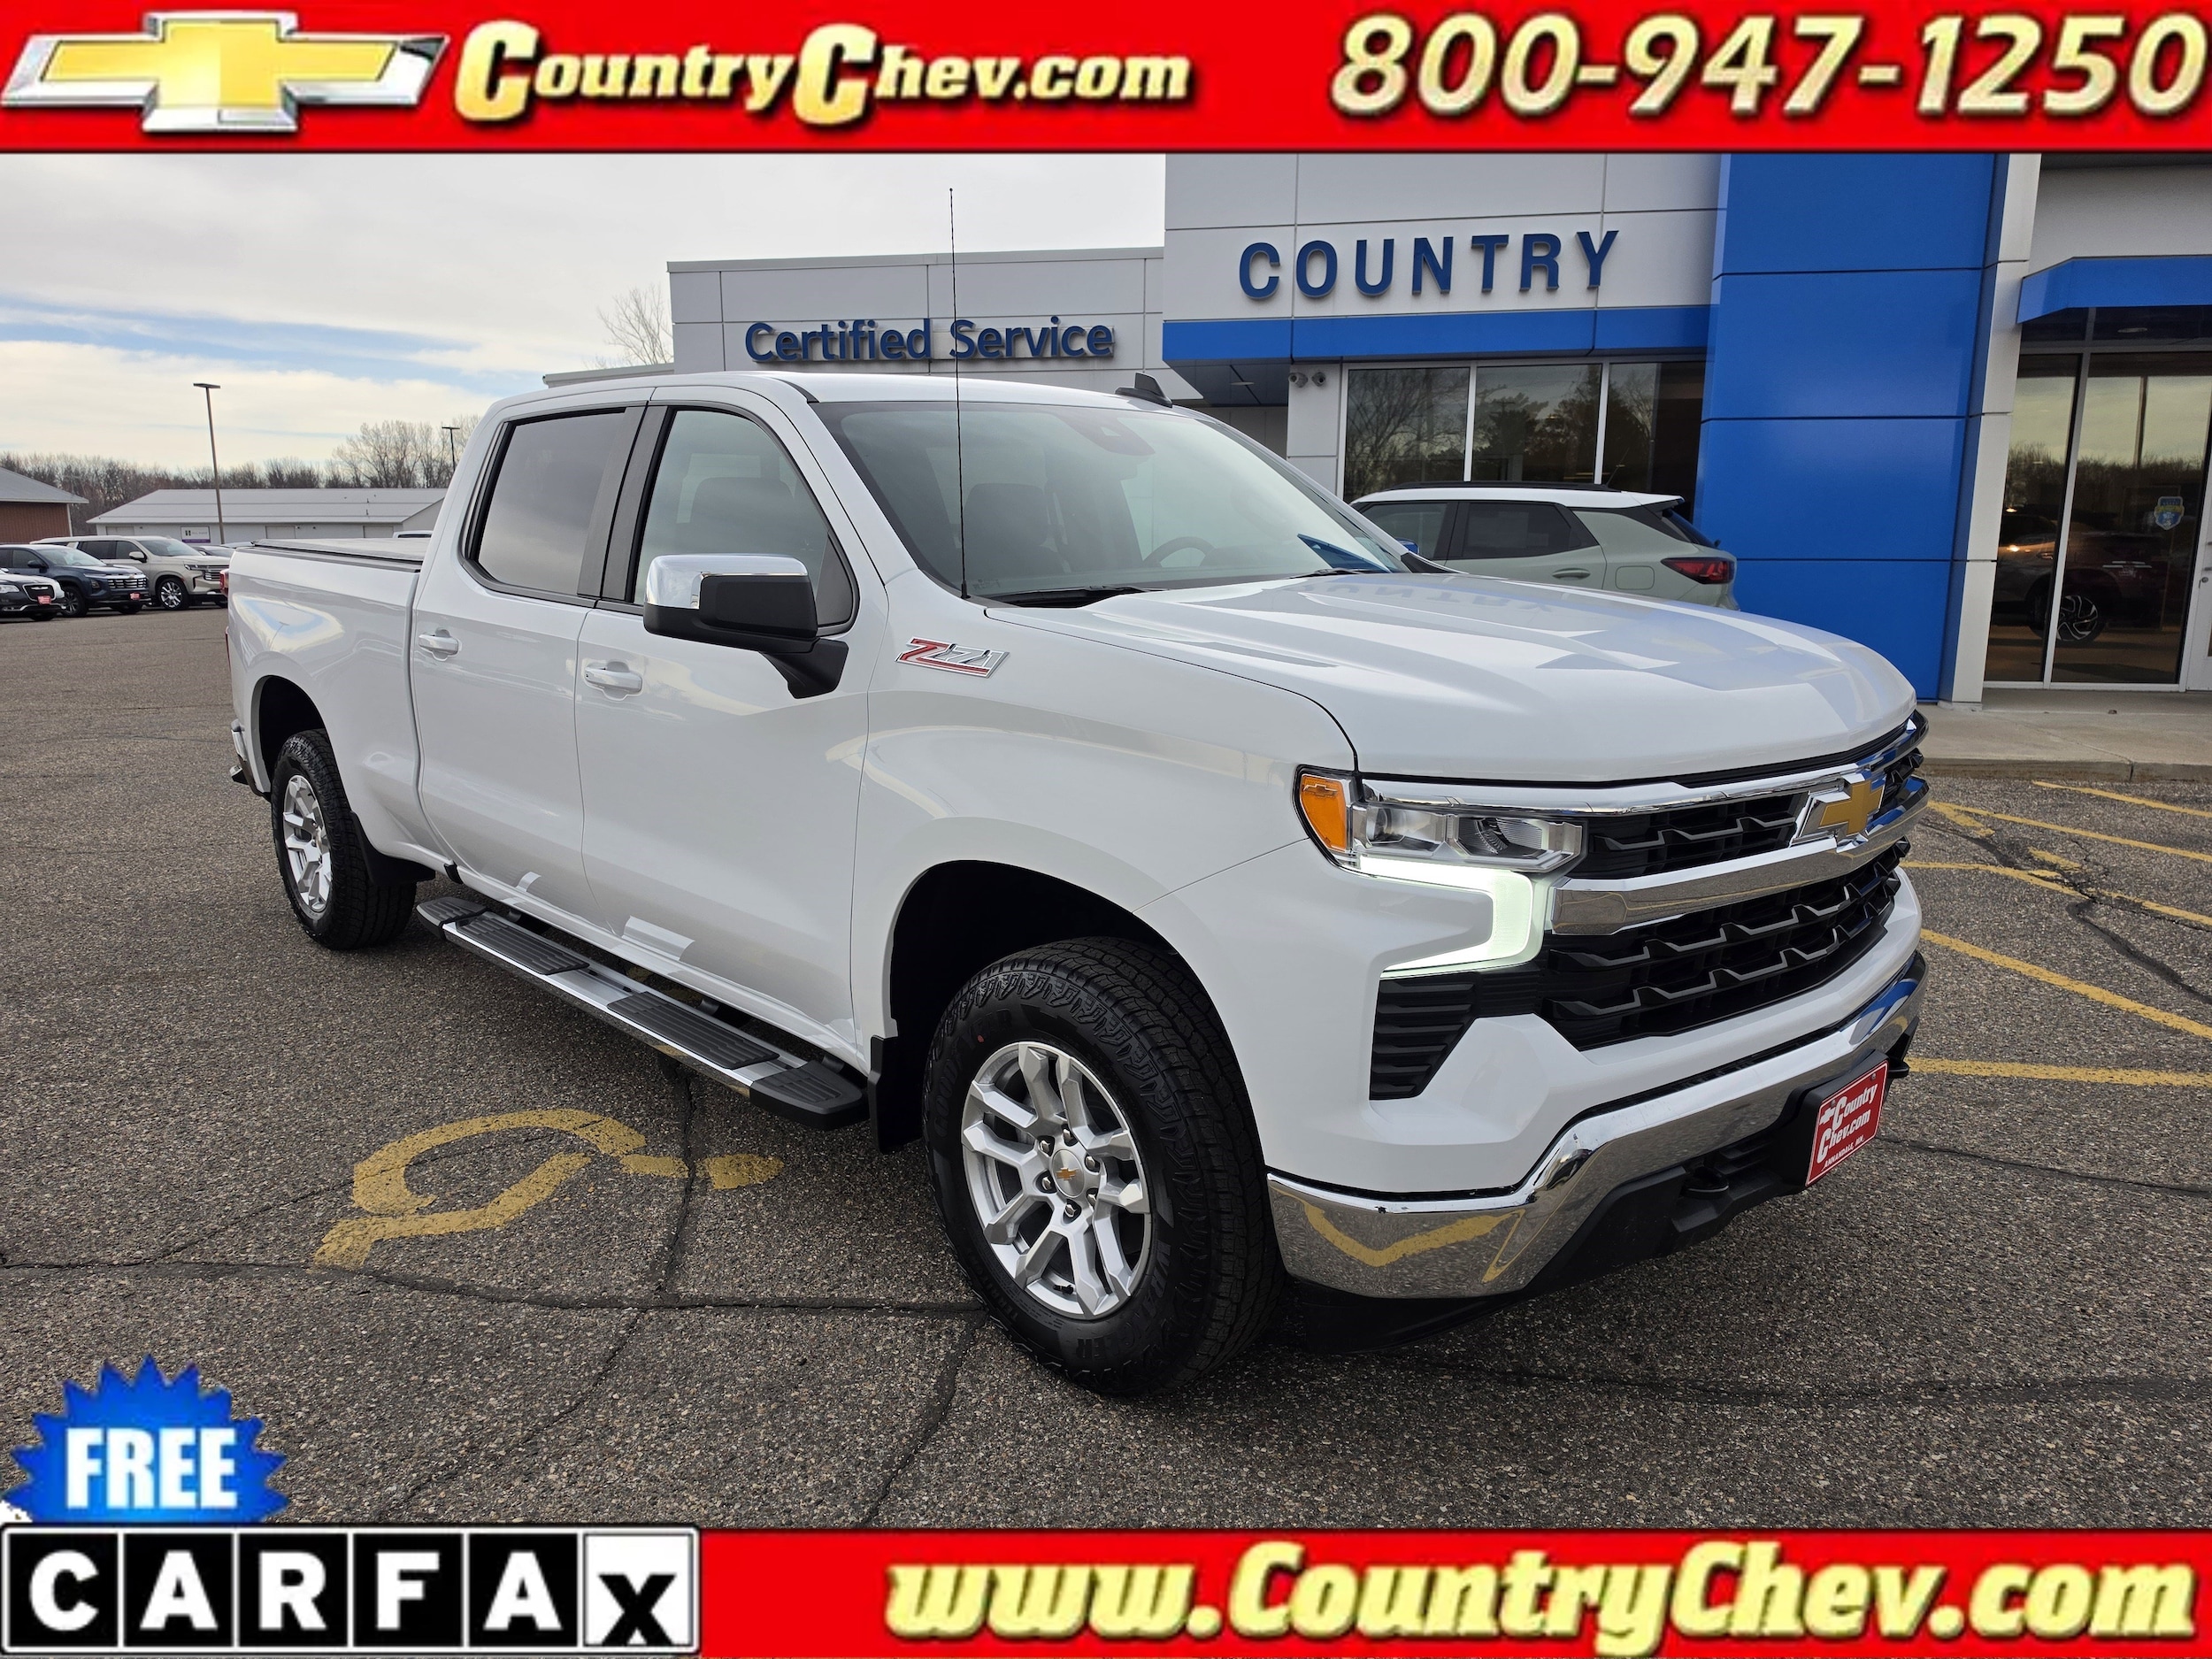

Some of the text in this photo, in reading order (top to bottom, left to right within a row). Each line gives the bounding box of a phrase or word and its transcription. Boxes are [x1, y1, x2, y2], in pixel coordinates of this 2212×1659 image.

[1239, 230, 1620, 301] COUNTRY
[745, 315, 1114, 362] Certified Service
[895, 636, 1010, 679] Z71
[1832, 1084, 1878, 1132] Country
[1816, 1110, 1871, 1164] Chev.com
